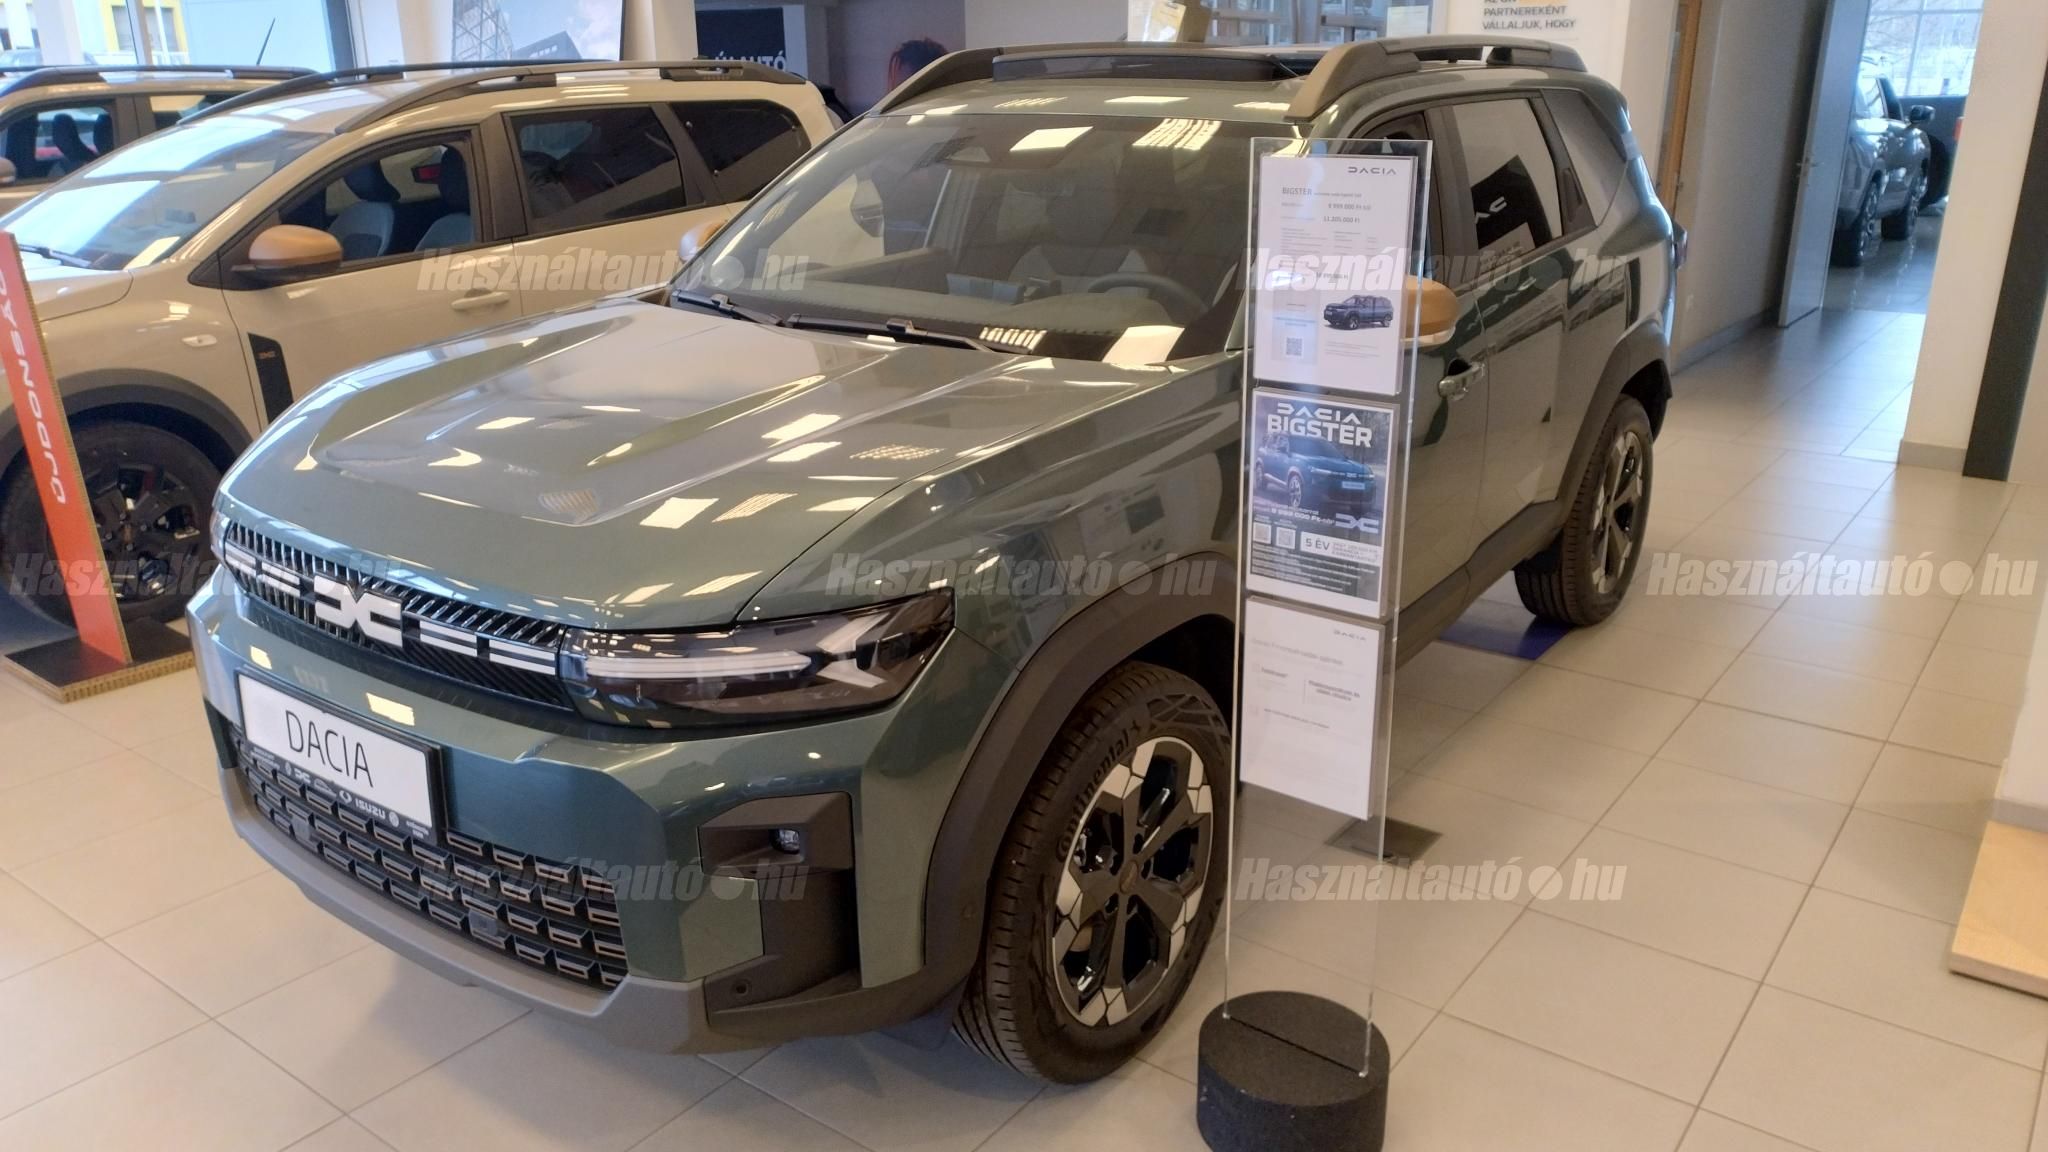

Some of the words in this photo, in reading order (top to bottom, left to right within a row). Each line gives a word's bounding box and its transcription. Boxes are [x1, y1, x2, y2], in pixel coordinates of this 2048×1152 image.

[1483, 4, 1567, 16] PARTNEREKÉNT
[1545, 18, 1577, 29] HOGY
[1347, 166, 1397, 175] DACIA
[1282, 186, 1313, 196] BIGSTER
[1277, 402, 1362, 425] DACIA
[1267, 414, 1373, 448] BIGSTER
[1305, 538, 1313, 547] 5
[1315, 537, 1330, 551] ÉV
[285, 710, 374, 788] DACIA
[355, 797, 386, 819] ISUZU
